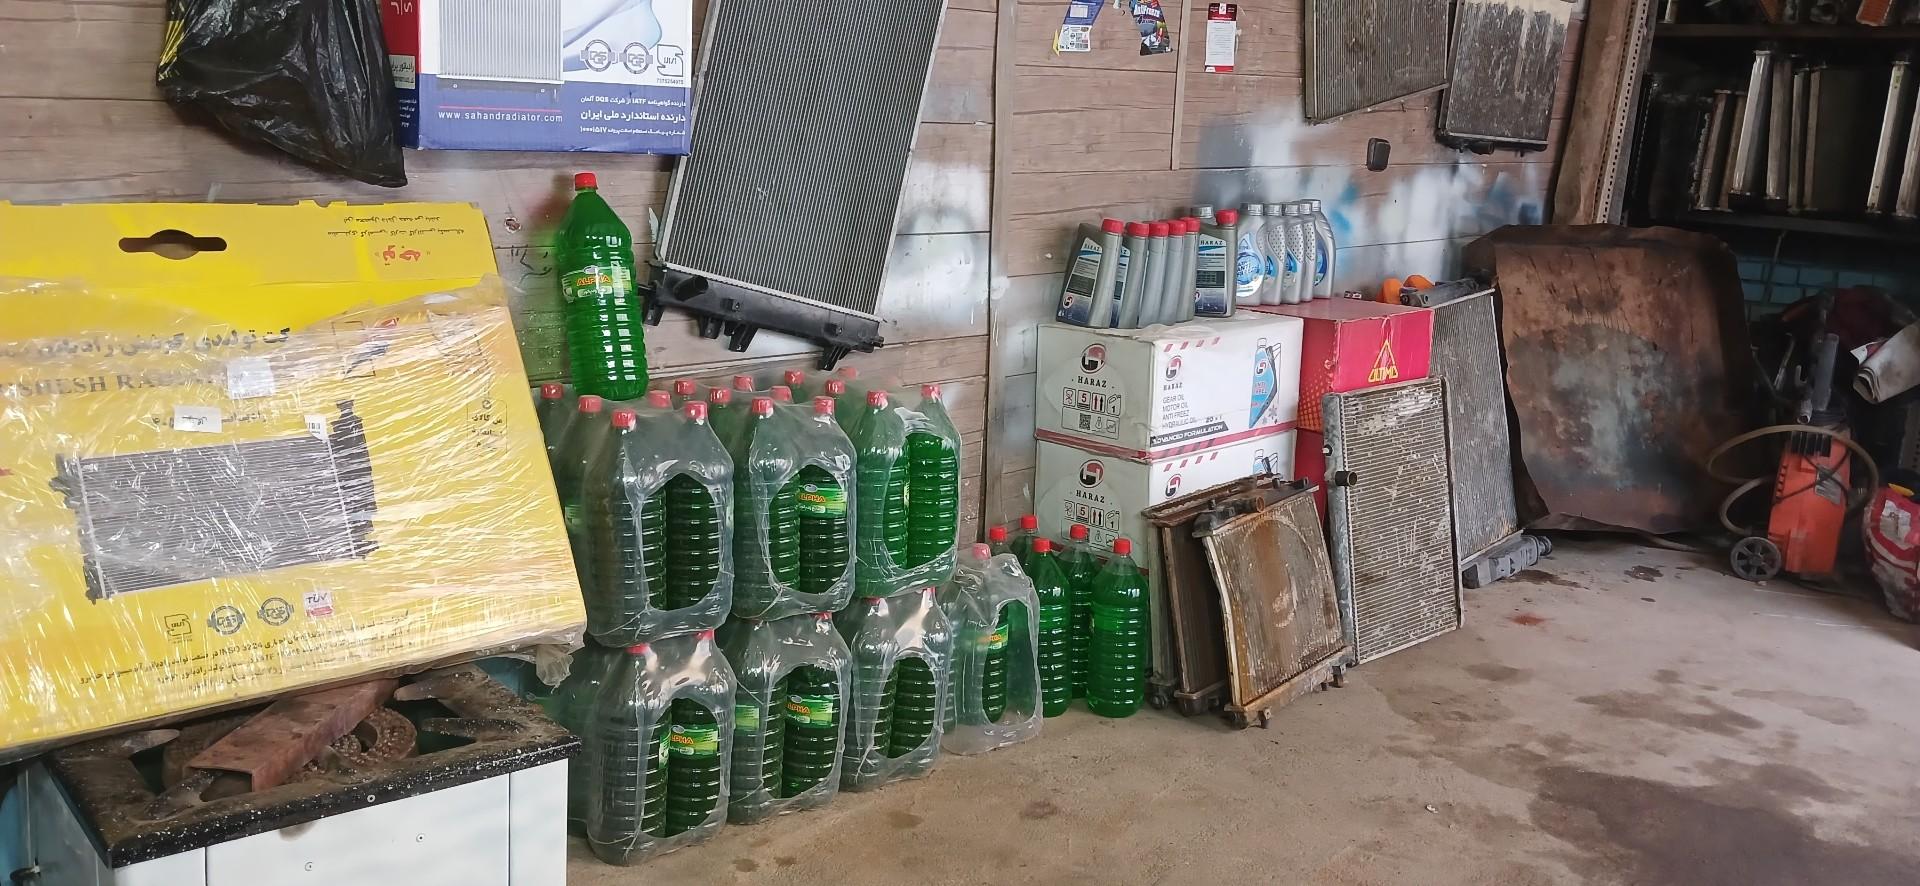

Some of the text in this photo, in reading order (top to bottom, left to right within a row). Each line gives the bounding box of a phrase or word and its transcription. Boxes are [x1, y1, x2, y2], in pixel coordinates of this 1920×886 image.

[610, 97, 626, 105] شرکت
[438, 111, 563, 122] www.sahandradiator.com
[580, 110, 686, 124] دارنده استاندارد ملی ایران
[382, 245, 421, 266] توجه
[576, 275, 610, 286] ALPHA
[1078, 376, 1107, 388] HARAZ
[1081, 394, 1086, 402] 5
[1162, 396, 1176, 404] GEAR
[1162, 403, 1180, 412] MOTOR
[1076, 490, 1105, 503] HARAZ
[1080, 507, 1086, 516] 5
[306, 592, 328, 604] TÜV
[672, 734, 694, 744] LPHA
